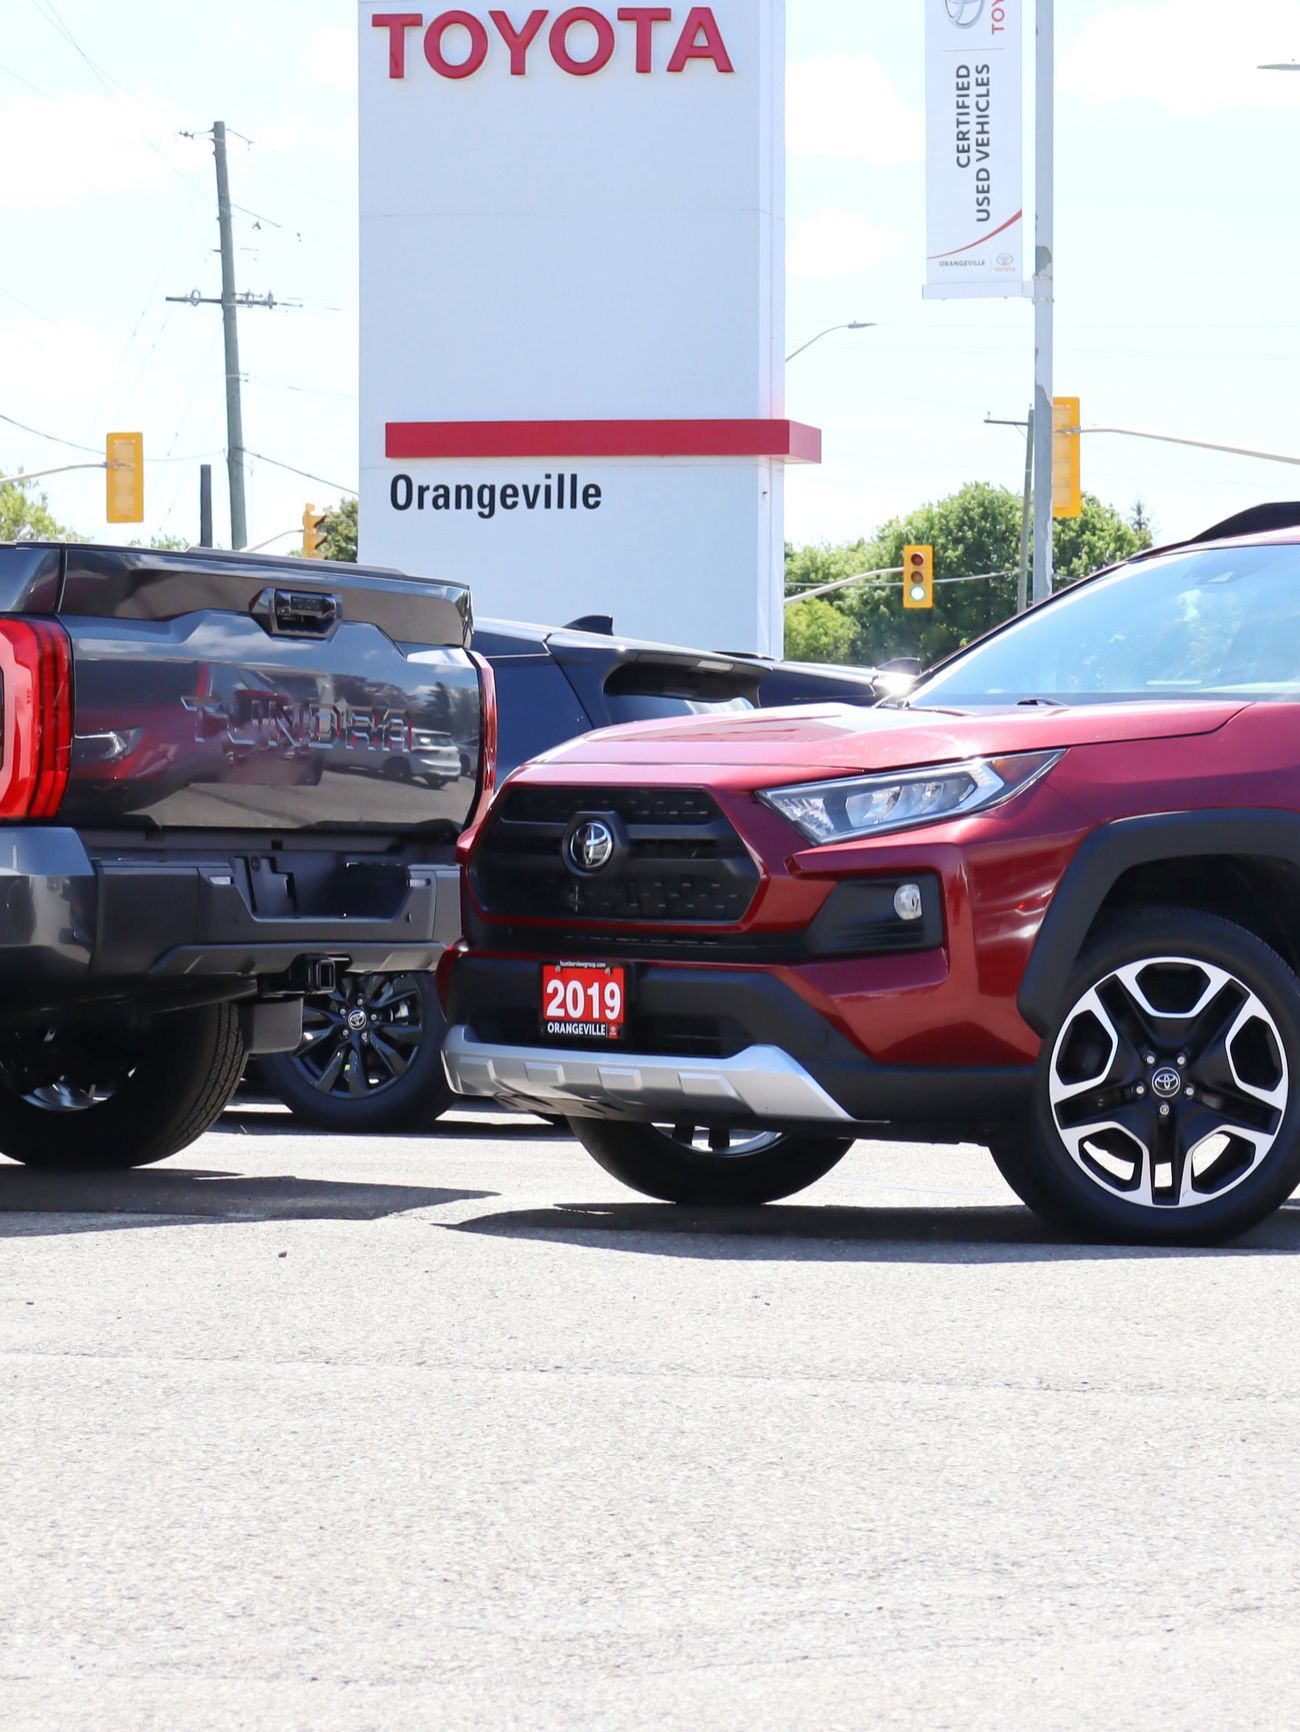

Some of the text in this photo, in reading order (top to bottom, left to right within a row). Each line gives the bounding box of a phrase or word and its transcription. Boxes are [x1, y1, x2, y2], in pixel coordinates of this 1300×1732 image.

[372, 6, 735, 80] TOYOTA
[956, 64, 971, 168] CERTIFIED
[975, 63, 991, 222] USED VEHICLES
[938, 259, 986, 267] ORANGEVILLE
[390, 473, 603, 519] Orangeville
[181, 696, 413, 753] TUNDRA
[546, 979, 621, 1020] 2019
[547, 1022, 606, 1036] ORANGEVILLE
